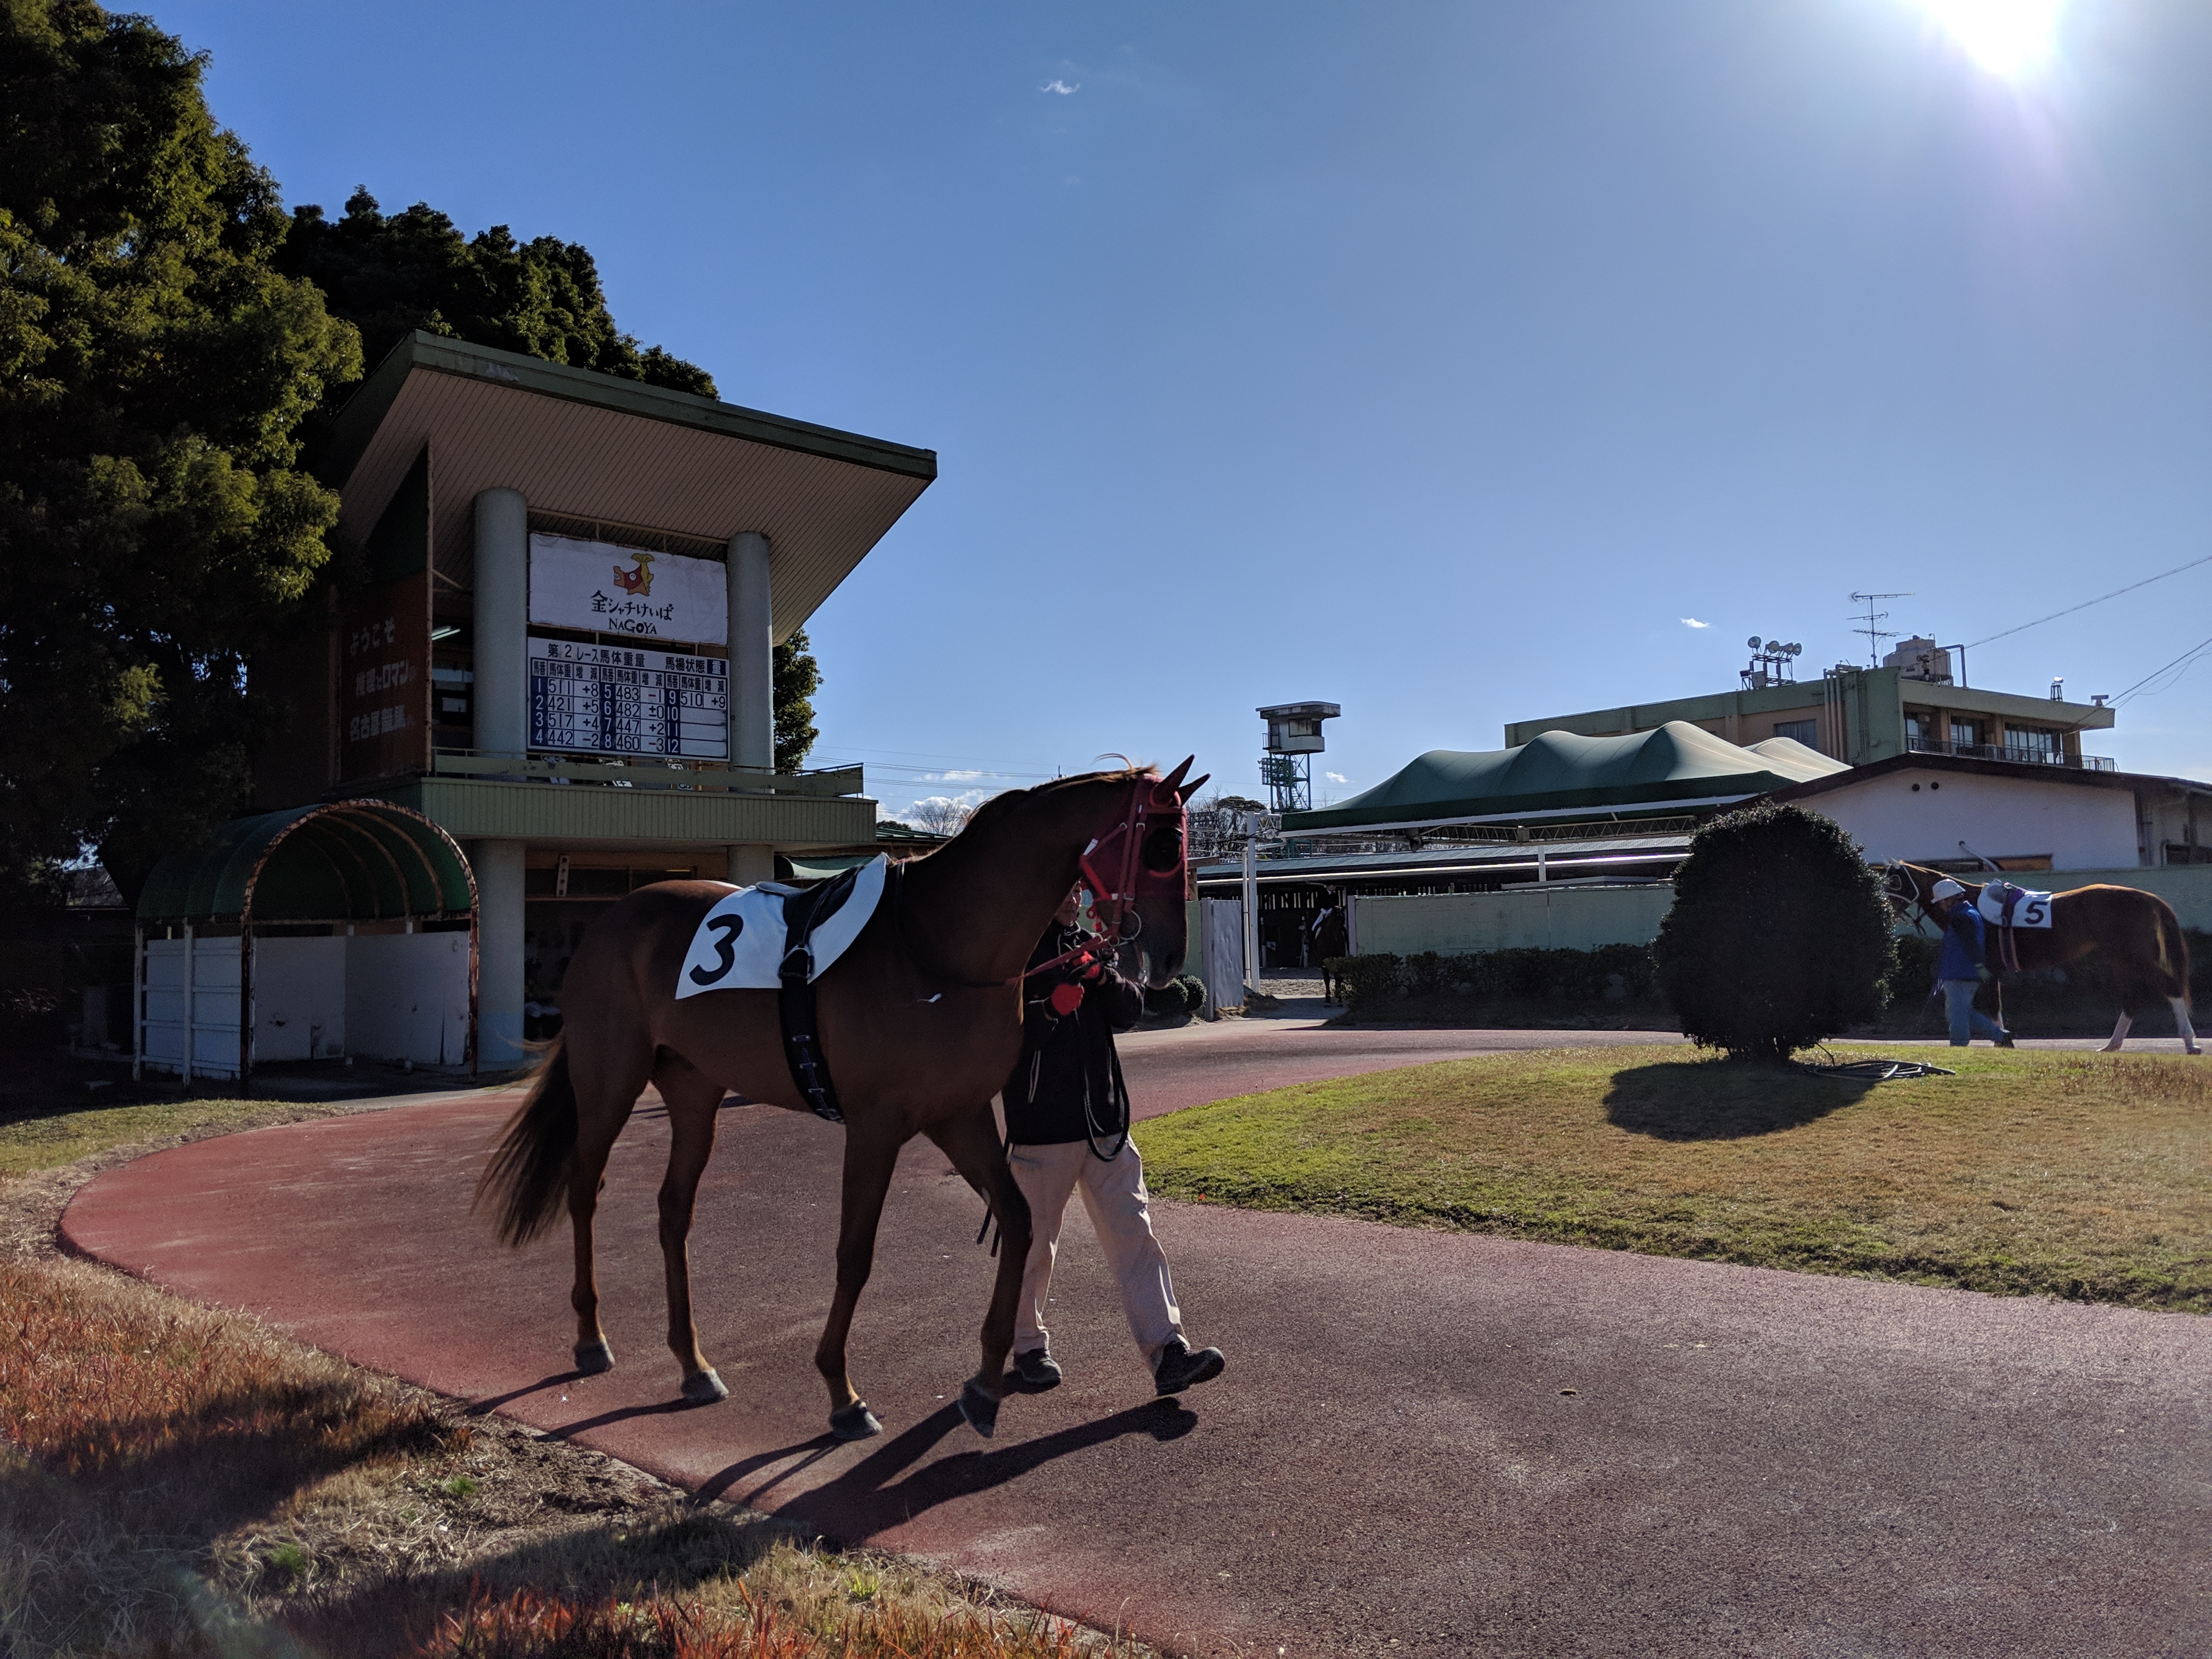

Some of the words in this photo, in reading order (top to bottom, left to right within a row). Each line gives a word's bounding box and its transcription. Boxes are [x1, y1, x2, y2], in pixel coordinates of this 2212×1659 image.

[590, 590, 674, 620] 金シャチけいば
[349, 616, 396, 656] ようこそ
[609, 618, 657, 635] NAGOYA
[550, 663, 571, 678] 馬体重
[617, 670, 637, 684] 馬体重
[681, 676, 701, 690] 馬体重
[665, 657, 705, 673] 馬場状態
[712, 661, 721, 674] 重
[549, 679, 570, 695] 511
[583, 683, 599, 697] +8
[604, 684, 612, 698] 5
[617, 686, 639, 701] 483
[669, 691, 676, 704] 9
[681, 692, 702, 706] 510
[712, 696, 725, 708] +9
[535, 695, 544, 710] 2
[548, 696, 570, 711] 421
[583, 699, 599, 713] +5
[604, 701, 611, 715] 6
[617, 702, 639, 717] 482
[667, 707, 678, 721] 10
[535, 712, 544, 726] 3
[549, 713, 573, 727] 517
[583, 716, 599, 730] +4
[604, 717, 612, 731] 7
[617, 718, 639, 733] 447
[649, 723, 664, 735] +2
[668, 723, 678, 737] 11
[536, 729, 543, 743] 4
[549, 730, 573, 745] 442
[605, 733, 611, 748] 8
[617, 735, 640, 750] 460
[668, 738, 679, 753] 12
[2024, 900, 2049, 924] 5
[689, 913, 743, 986] 3
